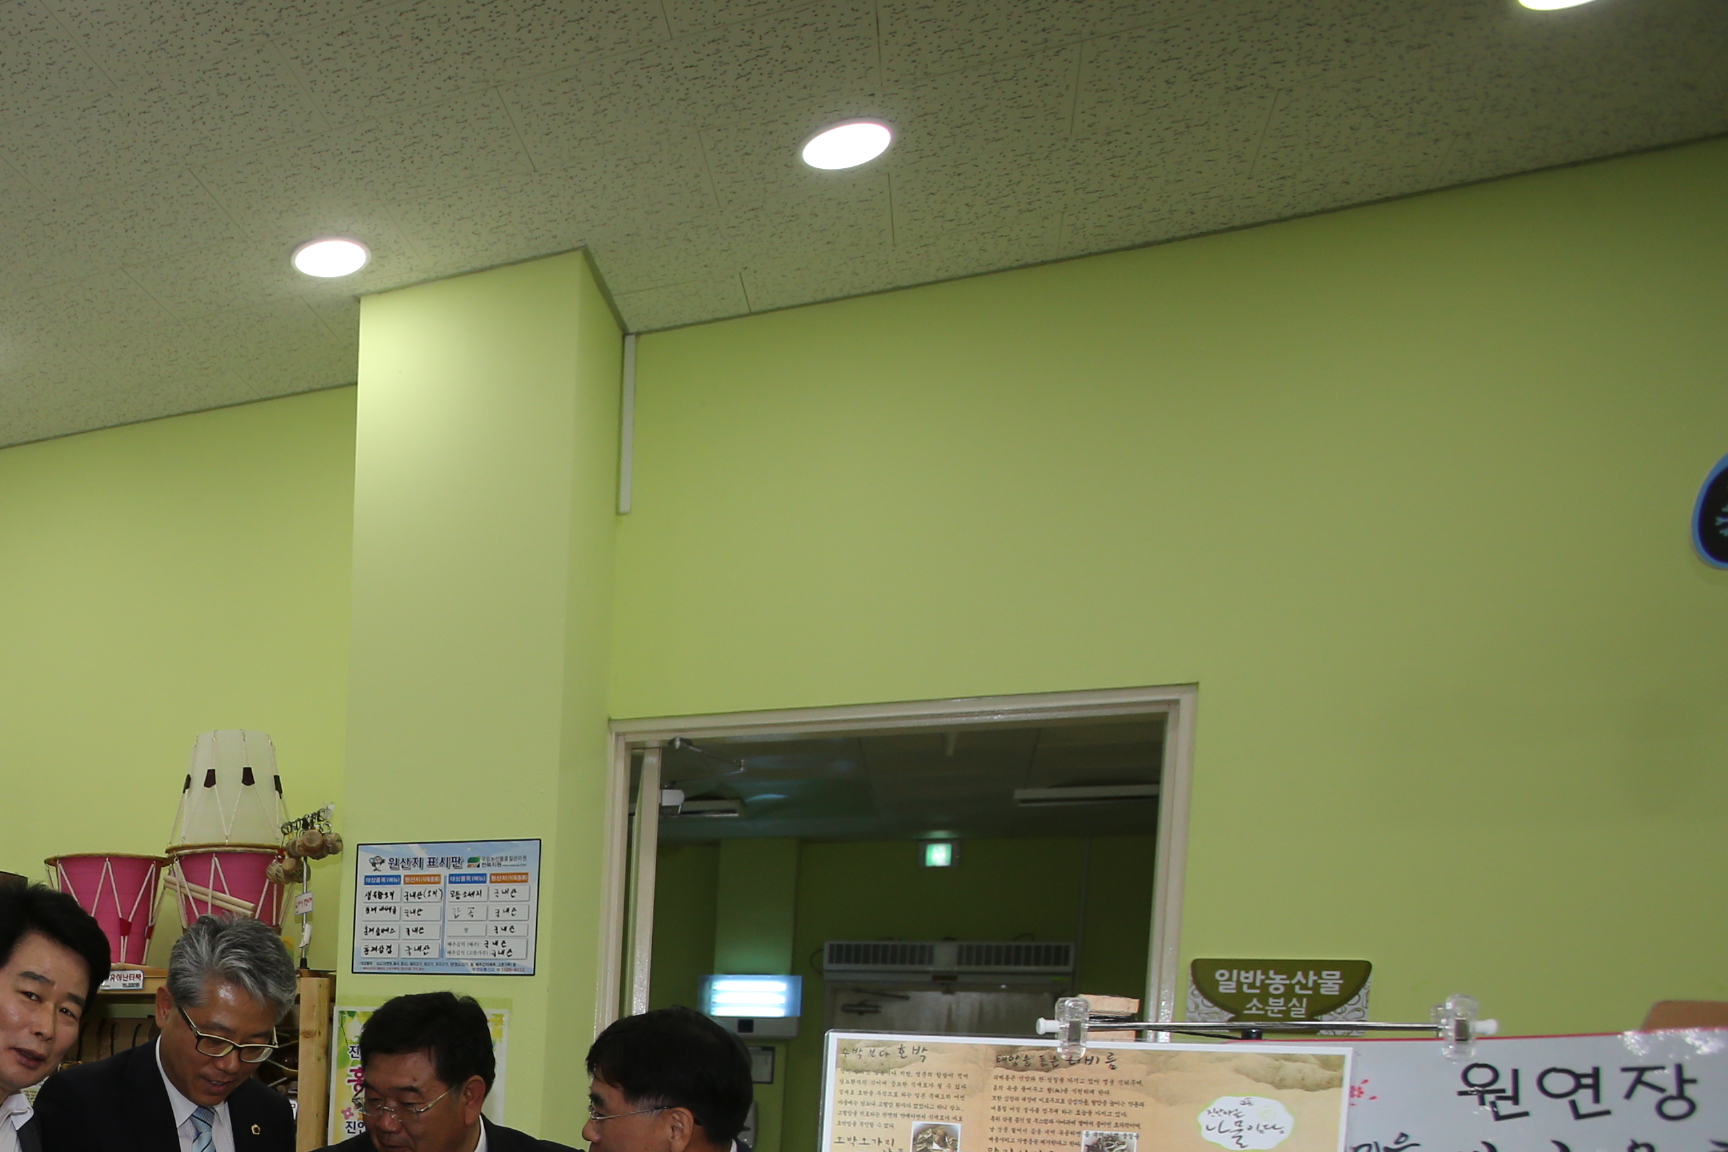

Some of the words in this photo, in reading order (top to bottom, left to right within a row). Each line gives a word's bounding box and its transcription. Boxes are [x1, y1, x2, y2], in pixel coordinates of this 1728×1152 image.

[387, 856, 424, 870] 원산지
[426, 855, 465, 869] 표시판
[493, 888, 518, 898] 국내산
[403, 907, 424, 918] 국내산
[494, 907, 518, 918] 국내산
[405, 926, 425, 936] 국내산
[493, 924, 516, 935] 국내산
[404, 944, 431, 956] 국내산
[1214, 968, 1344, 996] 일반농산물
[1243, 997, 1307, 1018] 소분실
[1456, 1062, 1698, 1122] 원연장
